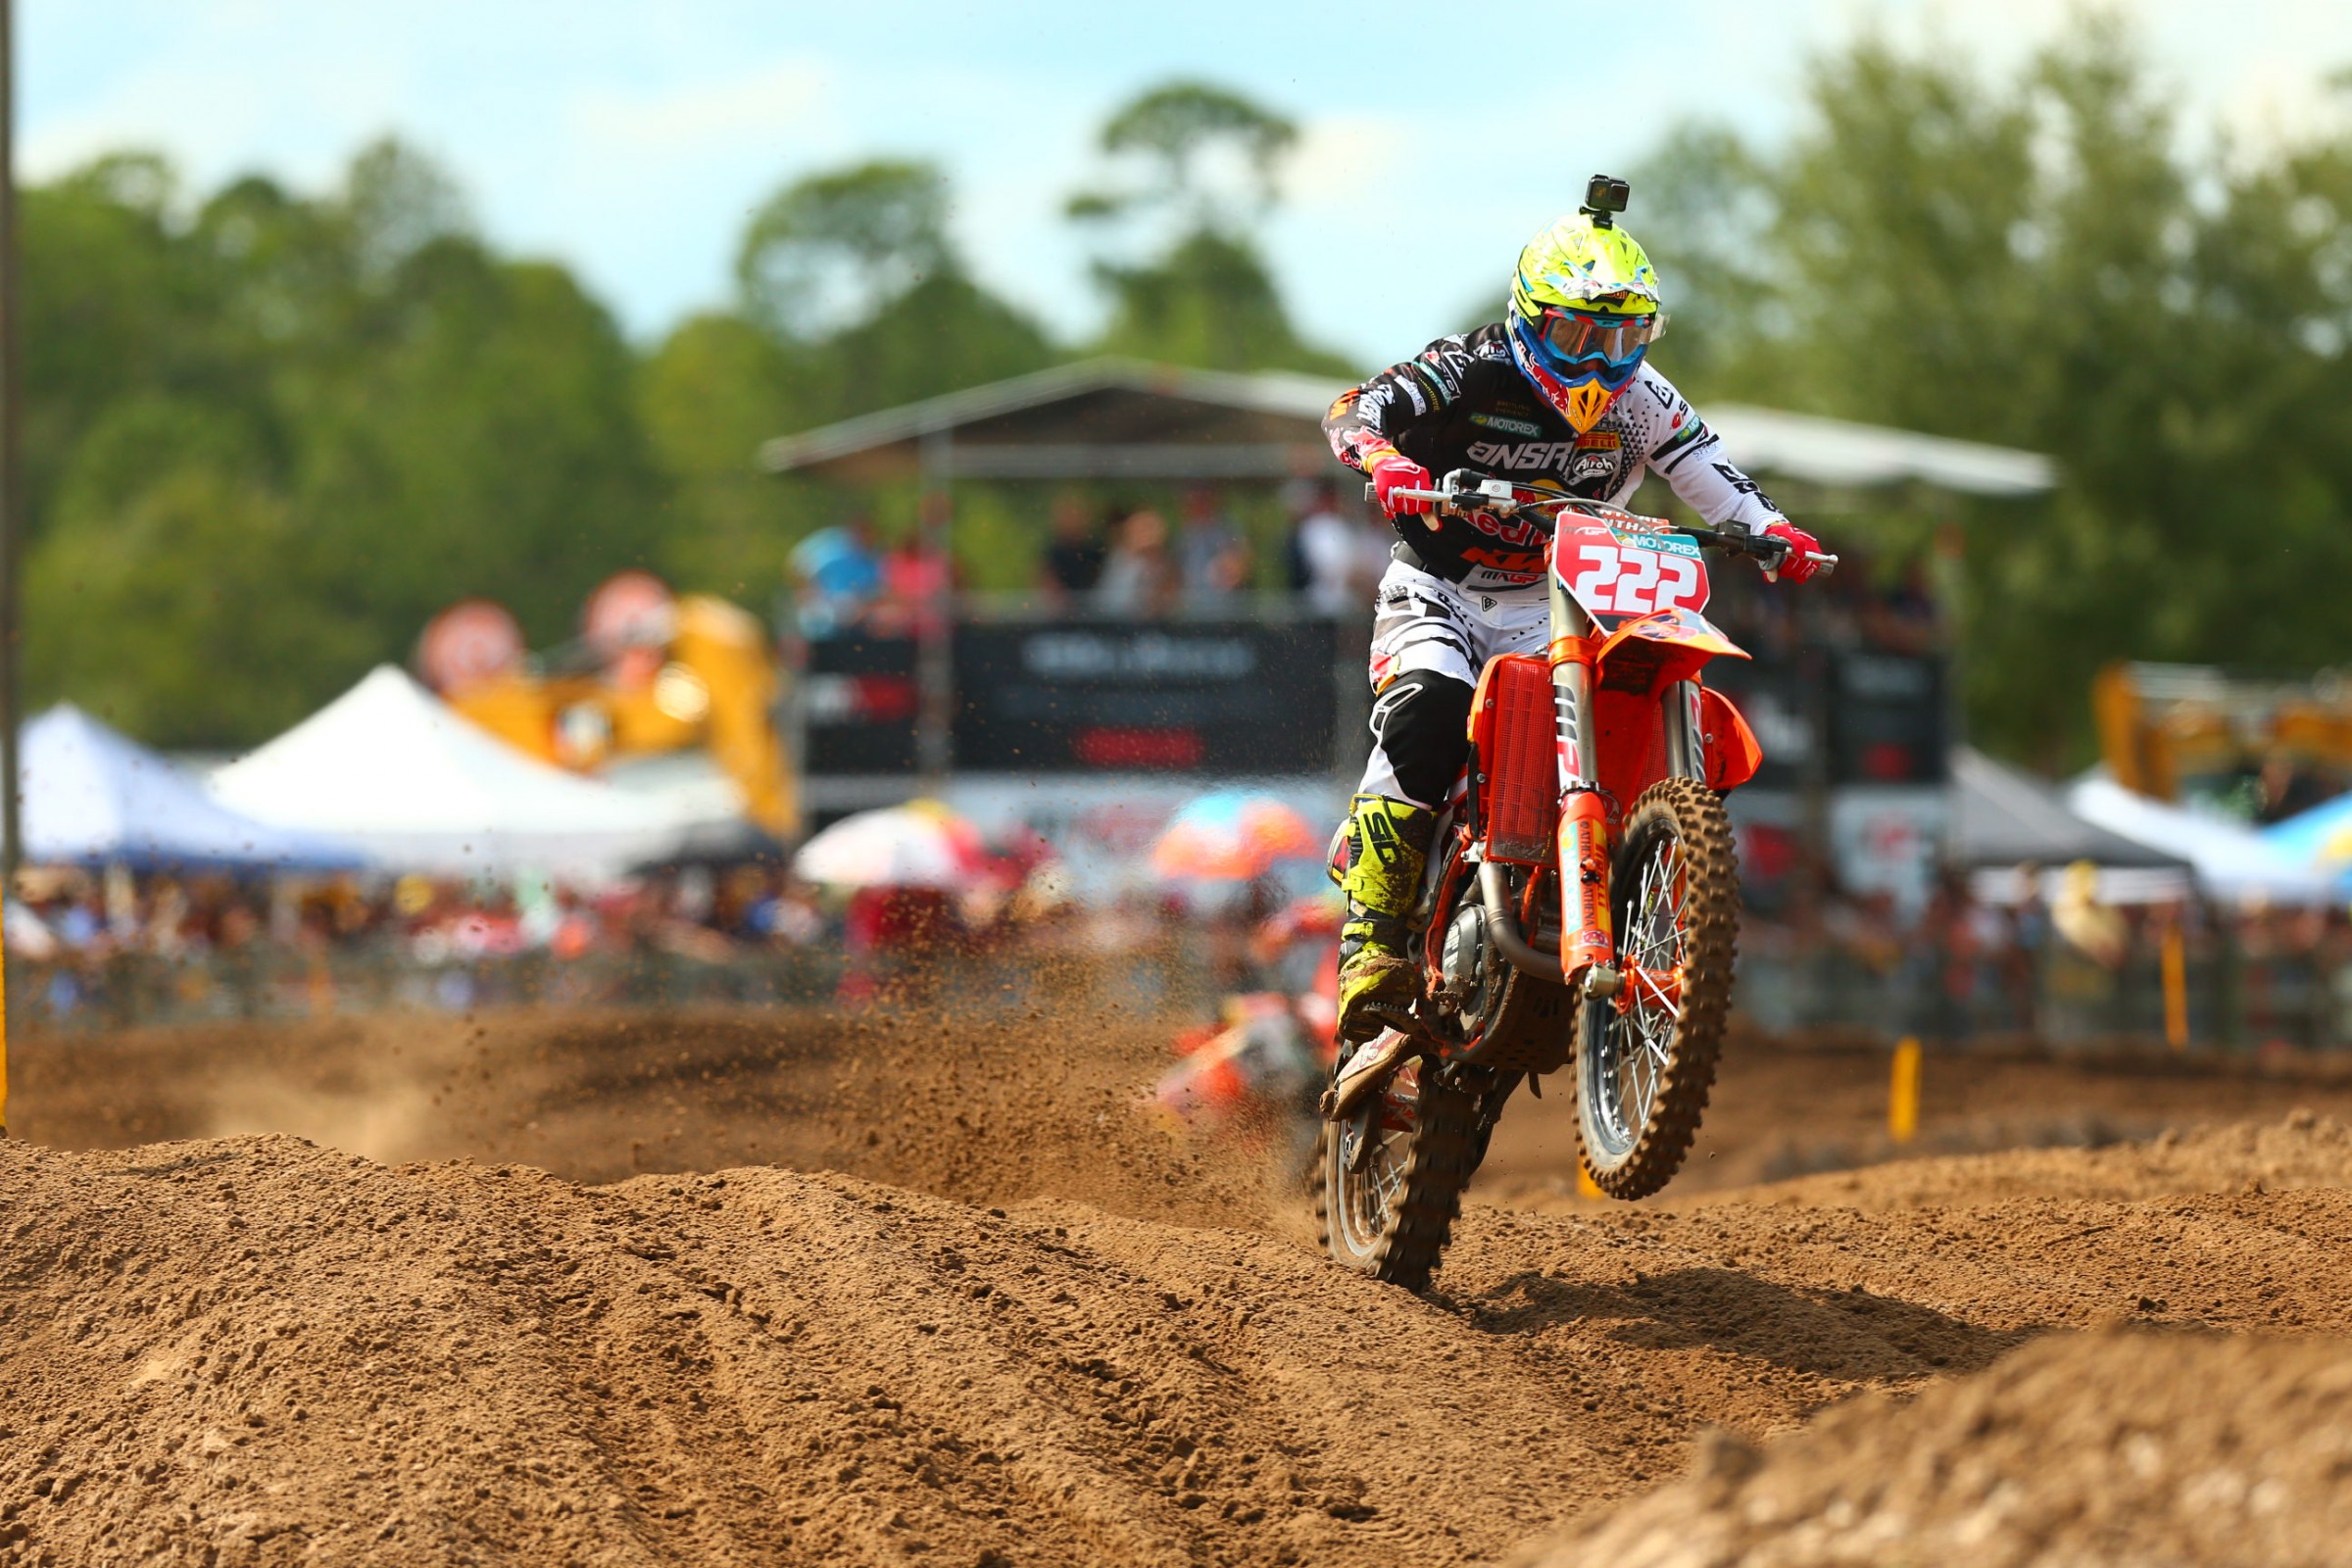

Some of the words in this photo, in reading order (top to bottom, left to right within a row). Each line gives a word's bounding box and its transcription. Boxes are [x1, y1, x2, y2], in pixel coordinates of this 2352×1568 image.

[1487, 415, 1539, 437] MOTOREX
[1575, 457, 1614, 471] Airoh
[1633, 534, 1701, 557] MOTOREX
[1574, 545, 1698, 613] 222
[1581, 828, 1592, 861] ATHEN
[1584, 885, 1595, 926] ATHENA
